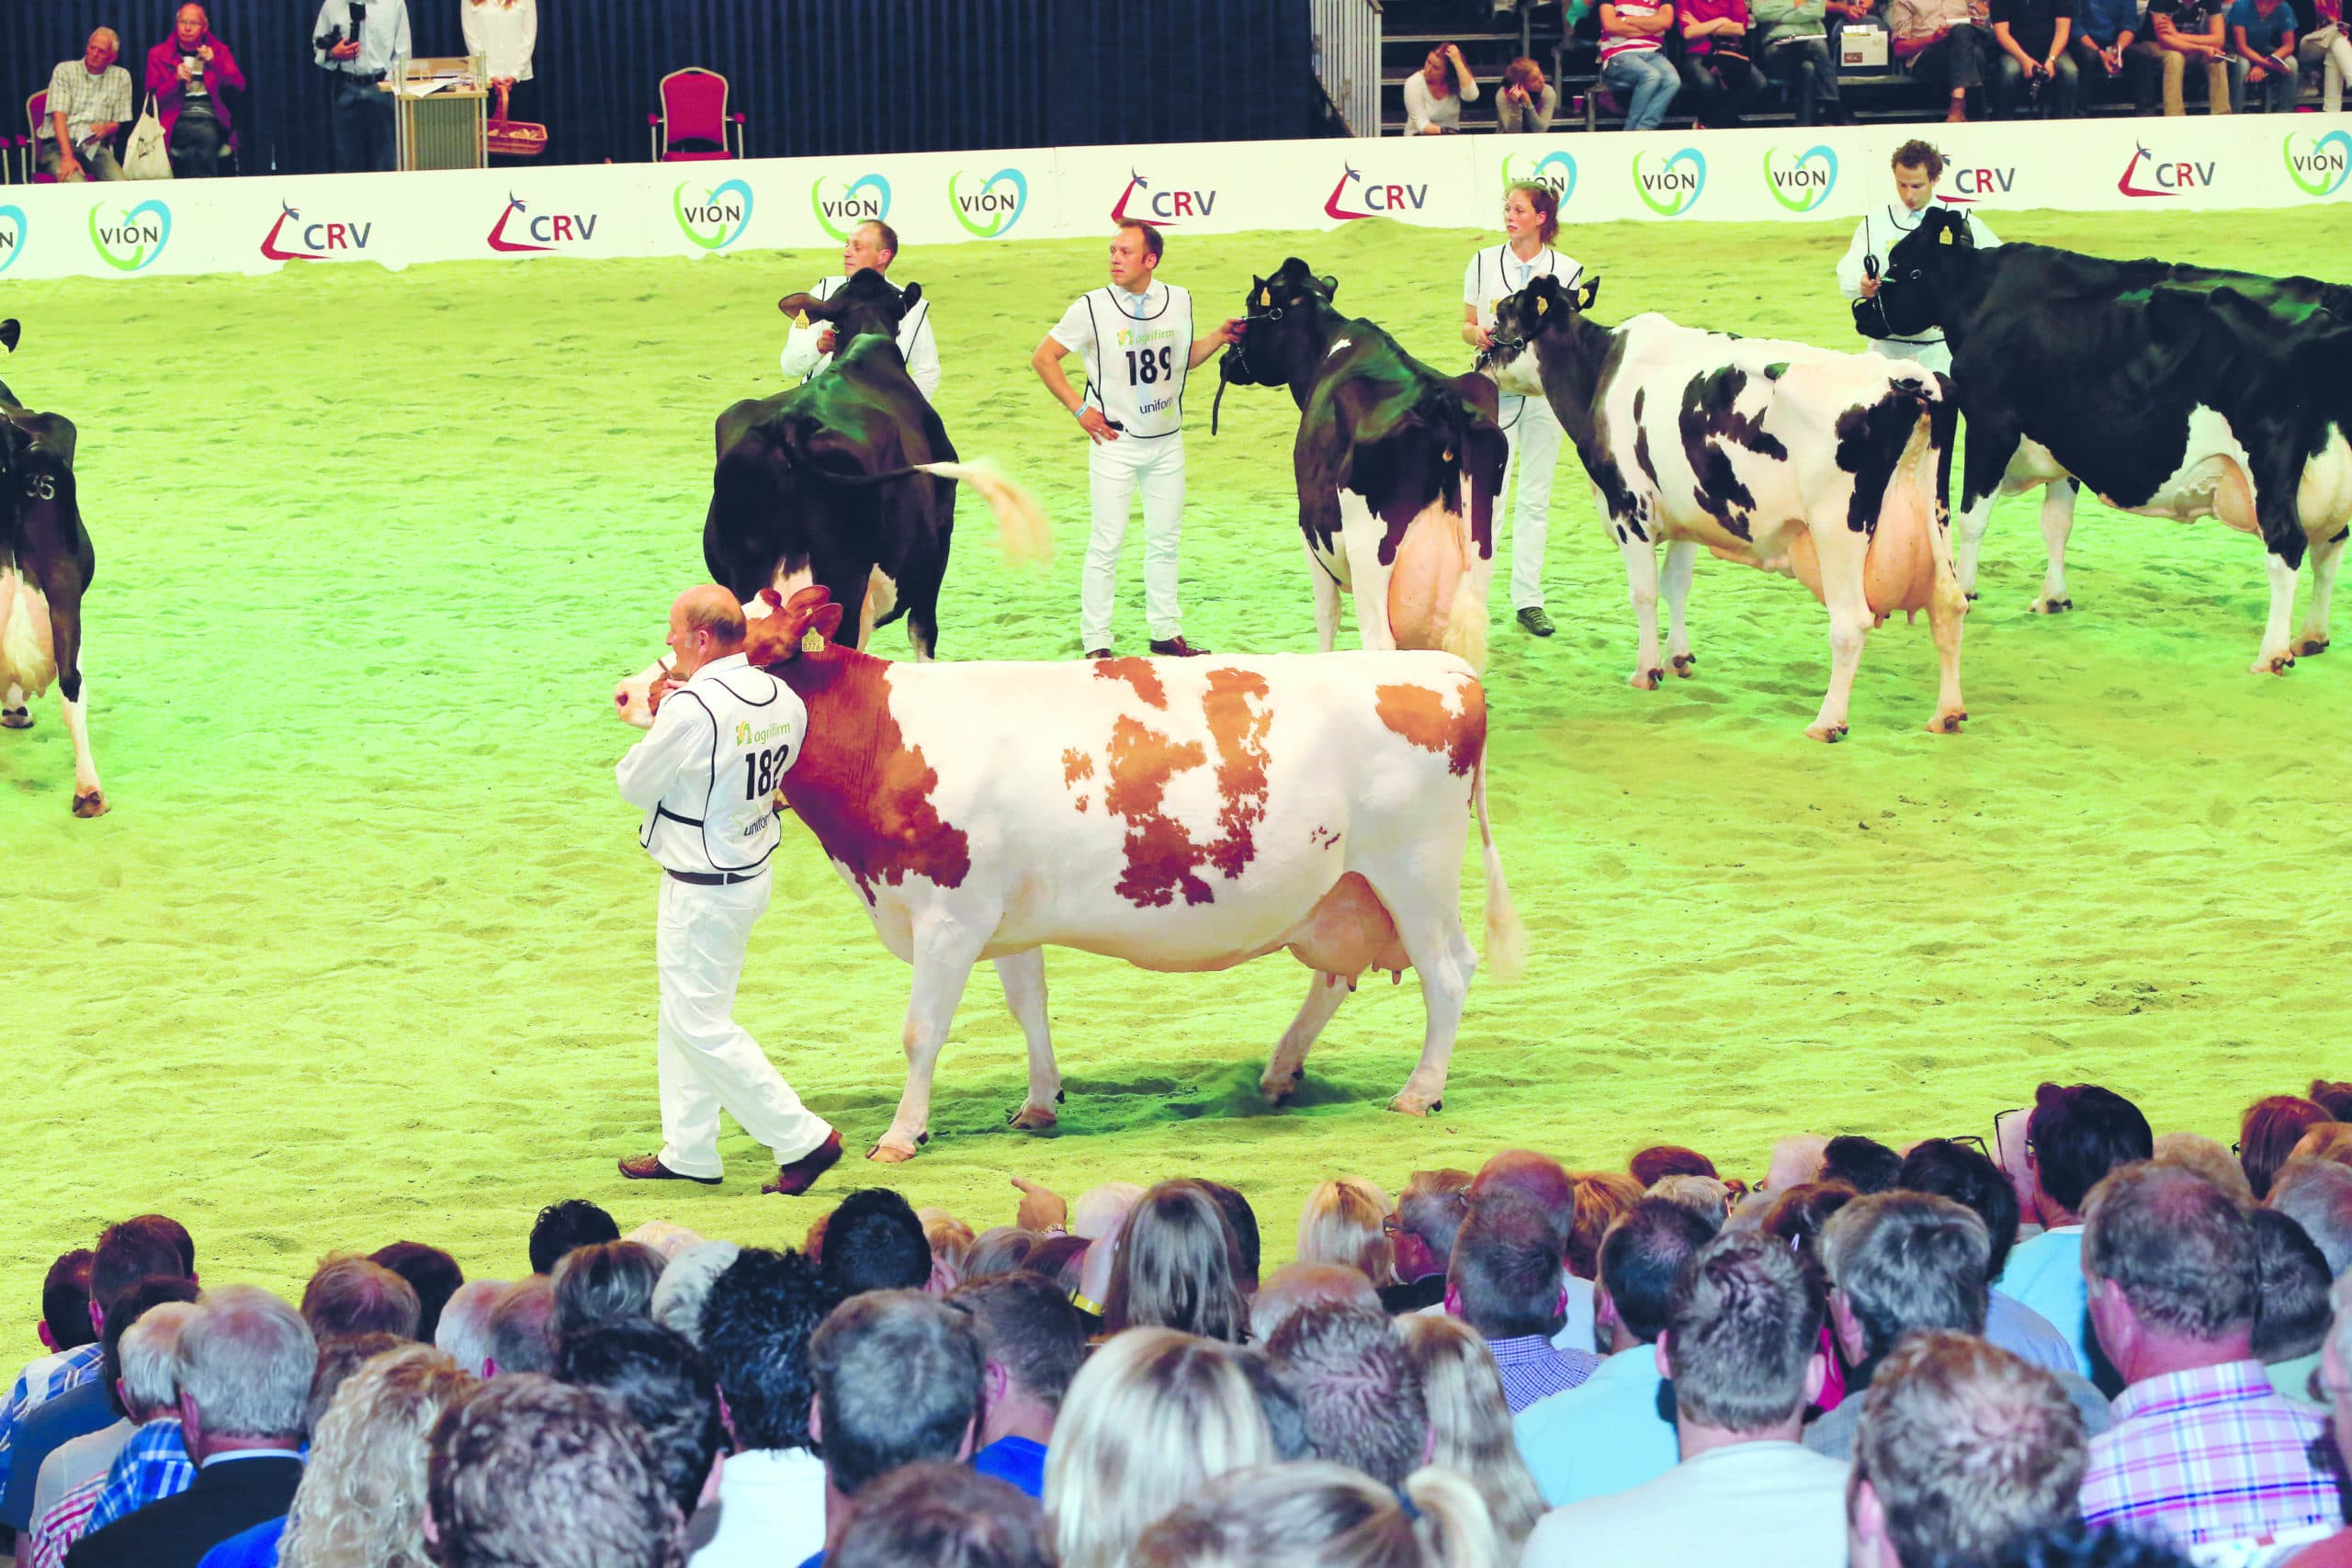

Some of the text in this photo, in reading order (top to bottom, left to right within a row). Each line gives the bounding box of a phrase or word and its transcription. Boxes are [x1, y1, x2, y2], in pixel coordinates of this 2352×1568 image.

[2293, 153, 2344, 171] VION
[1642, 174, 1696, 191] VION
[1773, 170, 1826, 187] VION
[1955, 167, 2016, 194] CRV
[2156, 162, 2216, 187] CRV
[822, 199, 878, 218] VION
[959, 195, 1015, 212] VION
[1152, 190, 1216, 217] CRV
[1364, 184, 1428, 210] CRV
[684, 206, 741, 223] VION
[99, 227, 159, 244] VION
[304, 222, 372, 251] CRV
[530, 214, 597, 242] CRV
[1135, 330, 1174, 345] agrifirm
[1125, 345, 1171, 386] 189
[754, 722, 791, 745] agrifirm
[745, 744, 790, 801] 182
